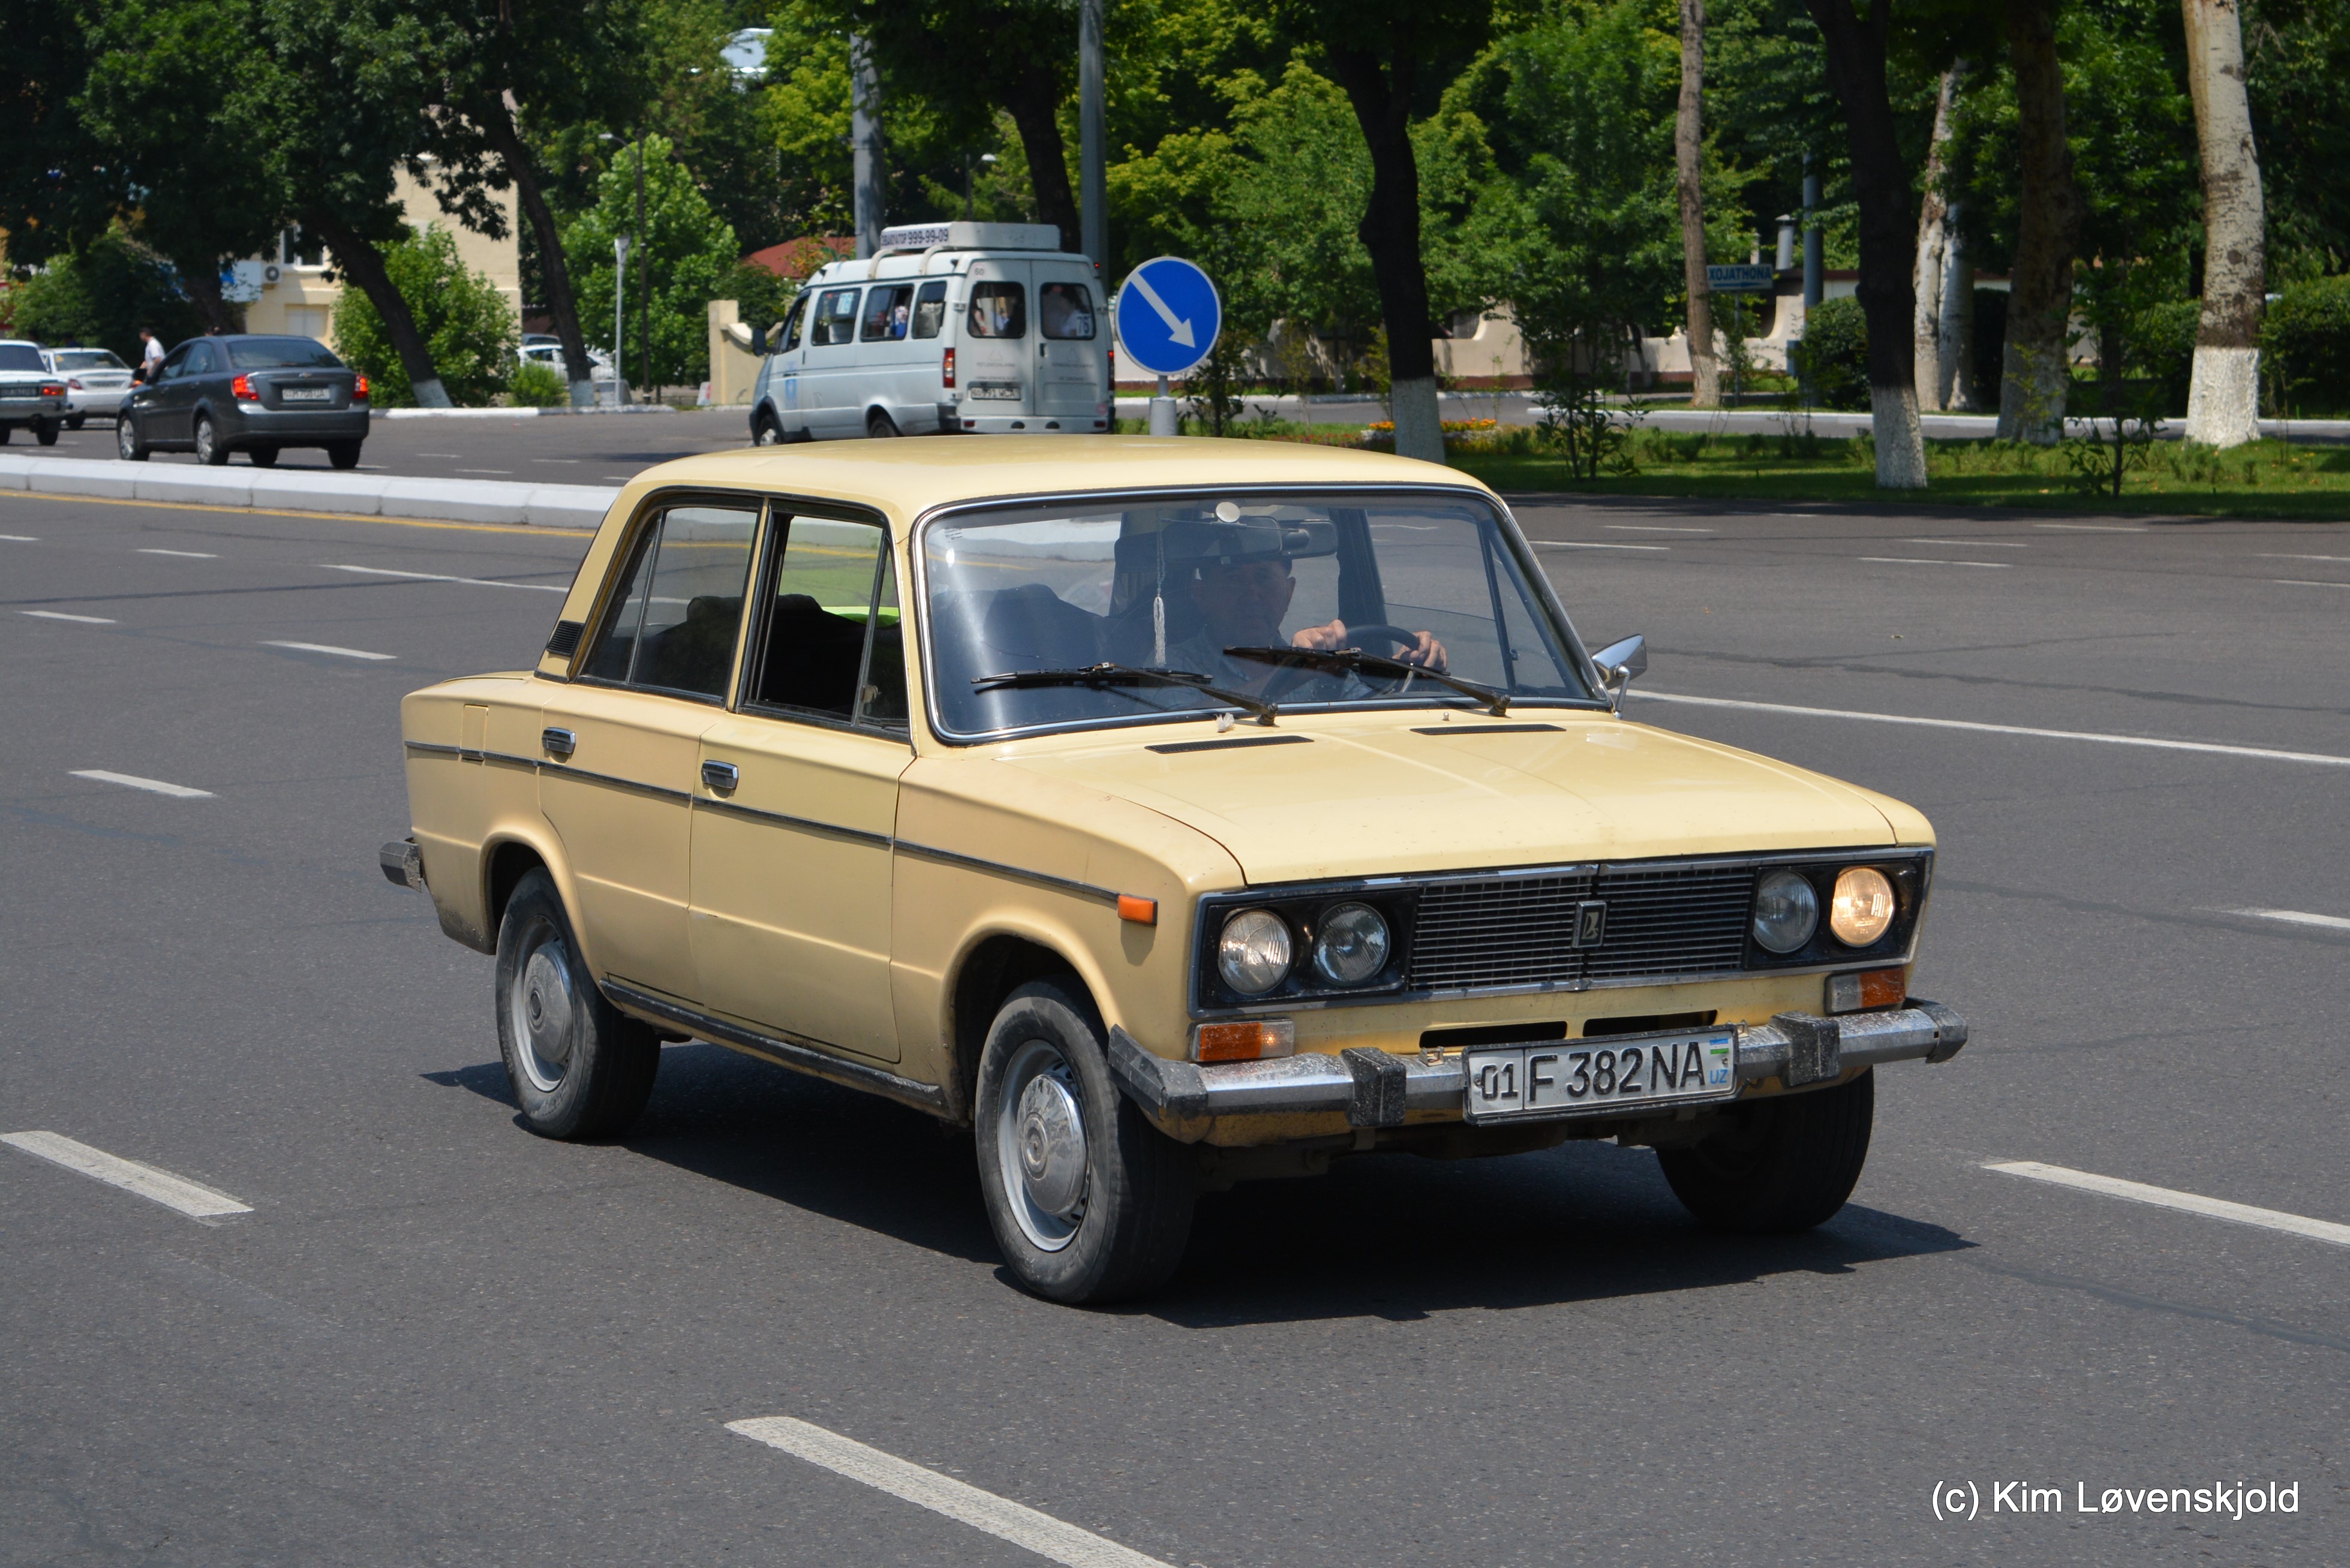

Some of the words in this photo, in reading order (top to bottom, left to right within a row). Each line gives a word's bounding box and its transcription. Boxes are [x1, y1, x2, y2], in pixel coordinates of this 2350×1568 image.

[908, 228, 948, 245] 999-99-09
[1077, 315, 1090, 334] 76
[1480, 1062, 1518, 1100] 01
[1528, 1054, 1558, 1101] F
[1567, 1047, 1643, 1098] 382
[1650, 1041, 1705, 1090] NA
[1709, 1069, 1728, 1084] UZ
